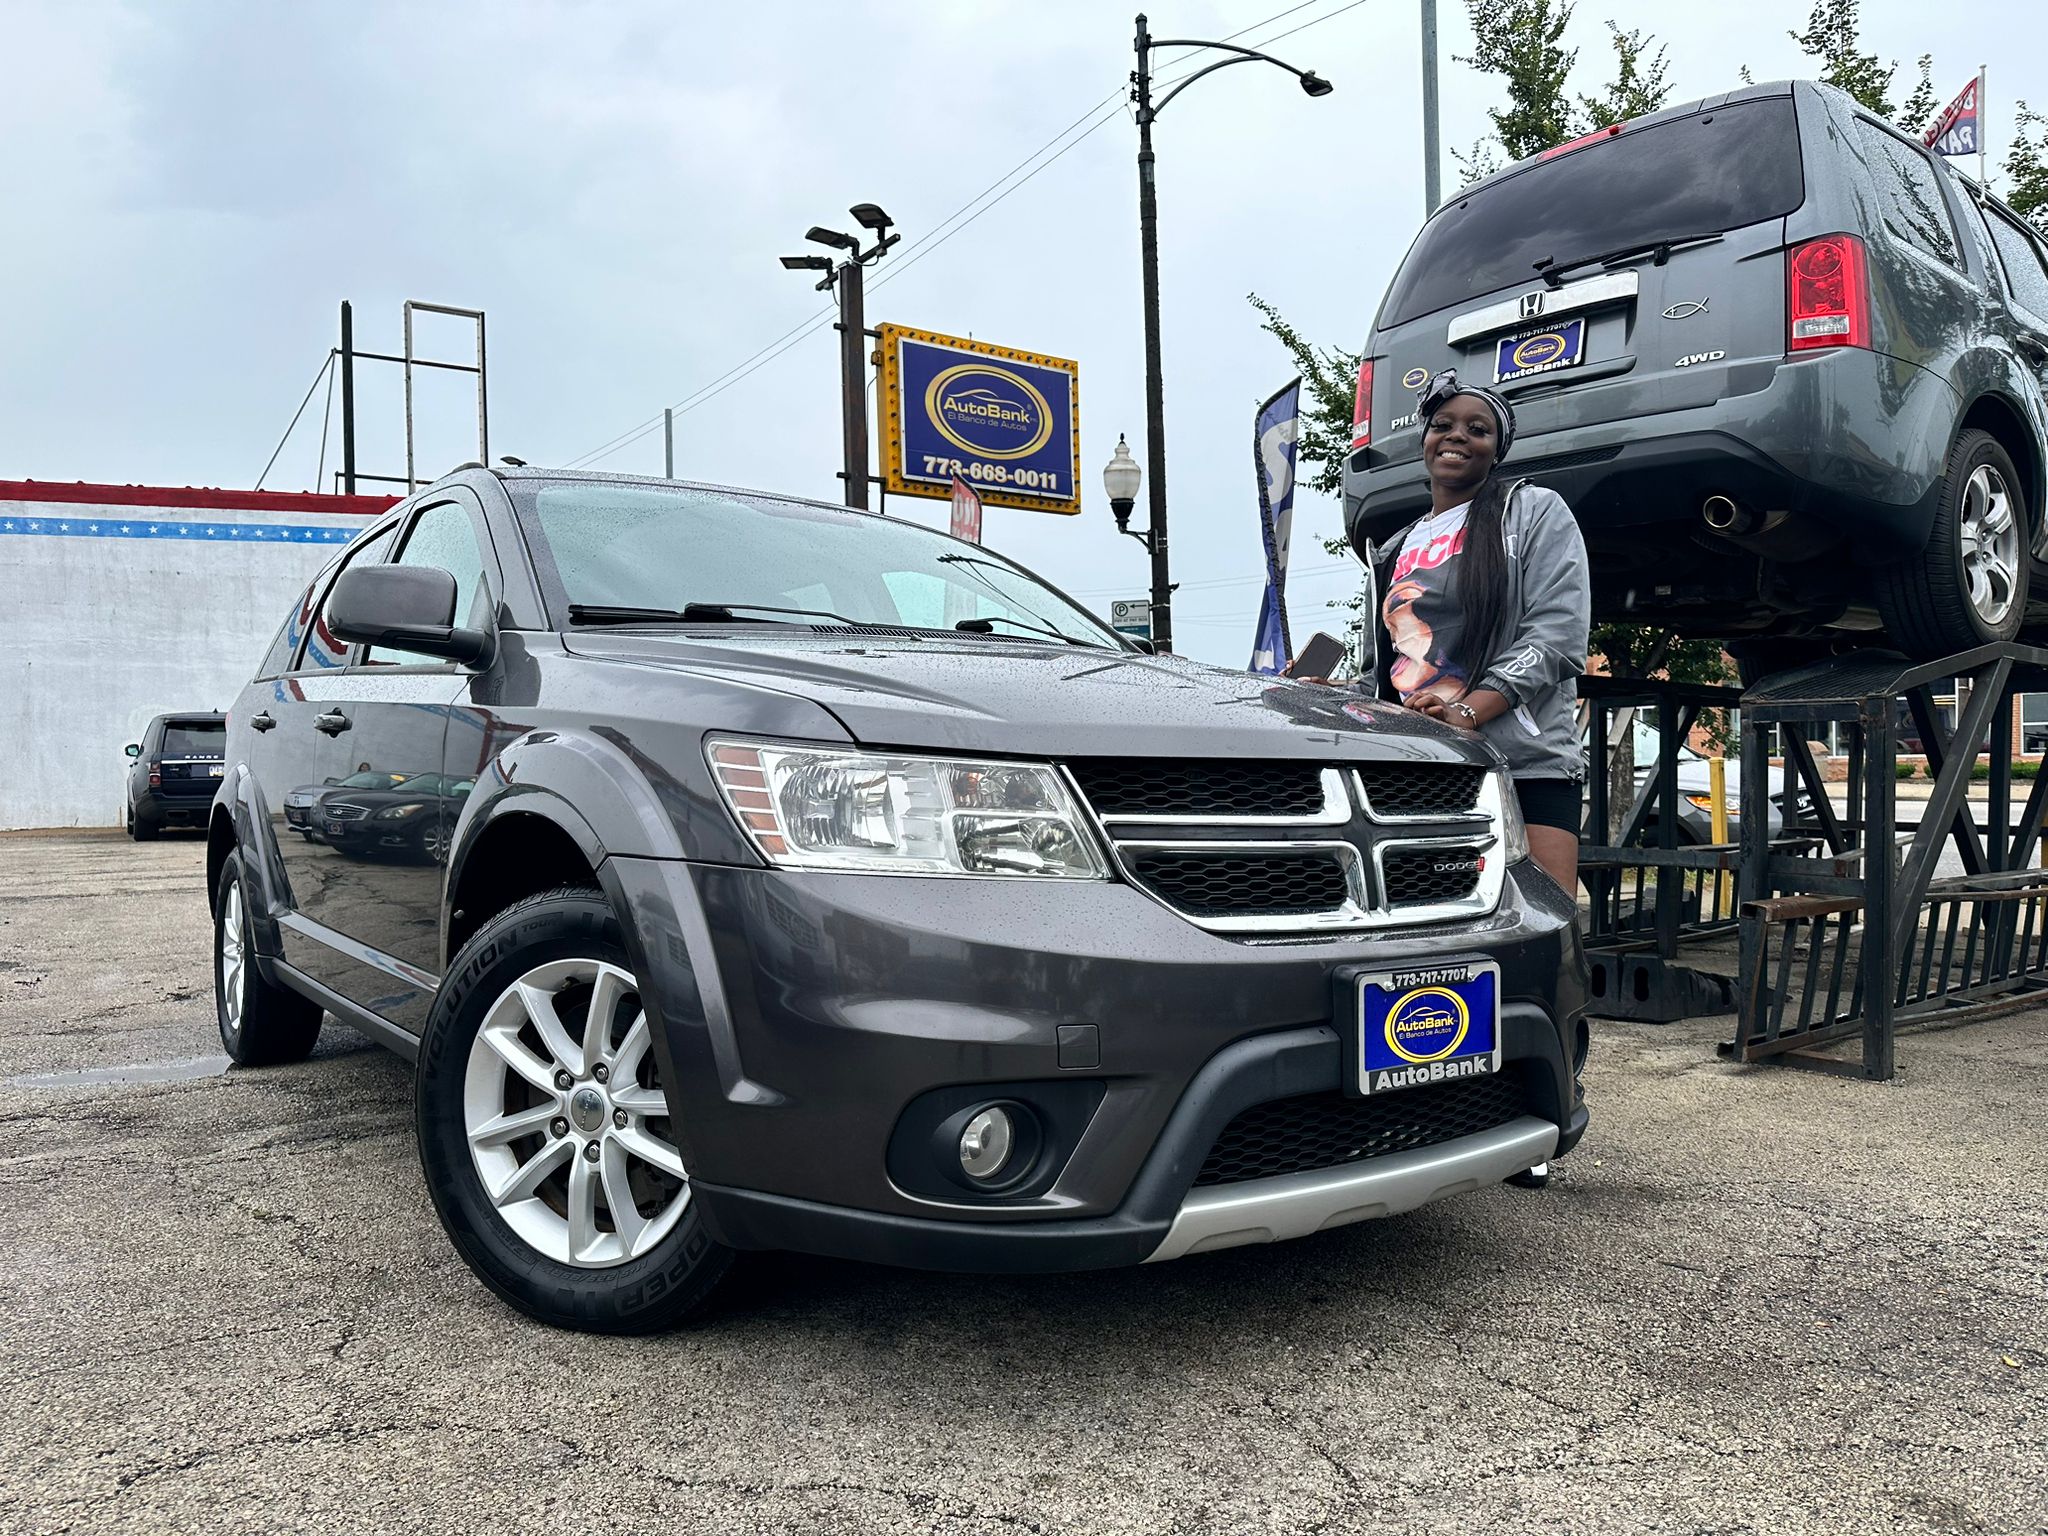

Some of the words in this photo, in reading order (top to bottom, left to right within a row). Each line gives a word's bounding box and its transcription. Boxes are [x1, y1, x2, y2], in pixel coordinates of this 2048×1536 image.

[1518, 323, 1563, 339] 773-717-7707
[1519, 344, 1556, 358] AutoBank
[1674, 350, 1726, 367] 4WD
[1501, 358, 1571, 381] AutoBank
[943, 397, 1031, 424] AutoBank
[948, 411, 956, 420] El
[958, 413, 987, 425] Banco
[988, 418, 999, 427] de
[1000, 420, 1027, 432] Autos
[923, 455, 1057, 490] 773-668-0011
[1395, 968, 1467, 987] 773-717-7707
[426, 930, 519, 1080] VOLUTION
[1396, 1015, 1454, 1034] AutoBank
[1405, 1031, 1425, 1039] Banco
[1426, 1028, 1433, 1036] de
[1434, 1027, 1452, 1035] Autos
[1375, 1056, 1487, 1091] AutoBank
[622, 1232, 708, 1312] OPER
